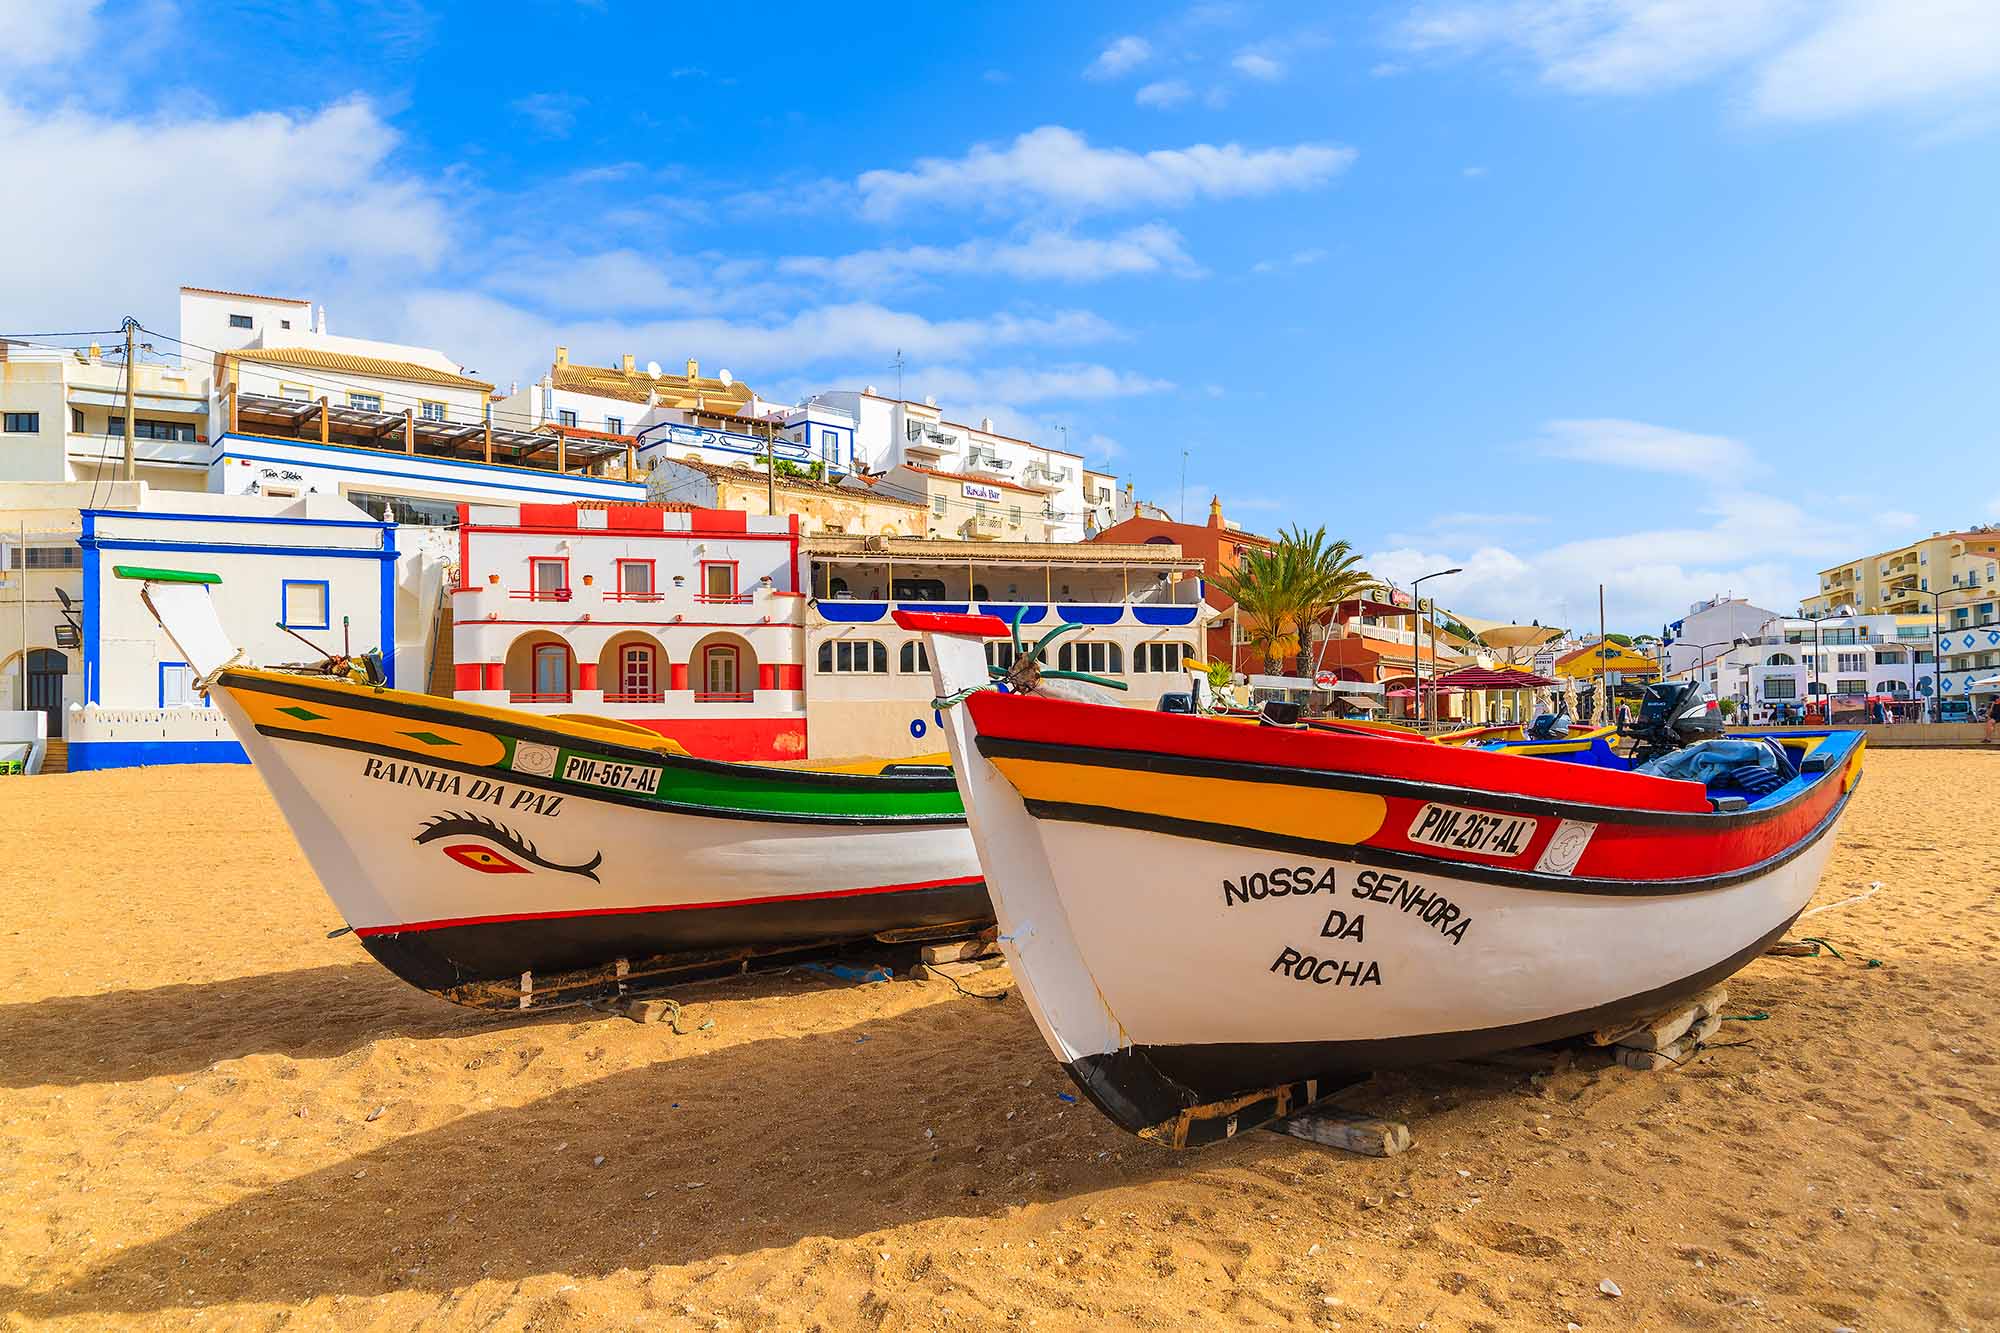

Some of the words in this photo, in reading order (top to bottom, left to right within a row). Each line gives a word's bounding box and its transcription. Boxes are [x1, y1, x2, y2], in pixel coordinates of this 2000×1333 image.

[965, 485, 987, 498] Rascals
[988, 489, 1000, 500] Bar
[363, 758, 461, 796] RAINHA
[466, 779, 505, 806] DA
[509, 789, 564, 817] PAZ
[566, 758, 657, 792] PM-567-AL
[1415, 807, 1525, 853] PM-267-AL
[1223, 866, 1336, 906] NOSSA
[1351, 870, 1473, 945] SENHORA
[1320, 910, 1364, 943] DA
[1270, 946, 1382, 986] ROCHA
